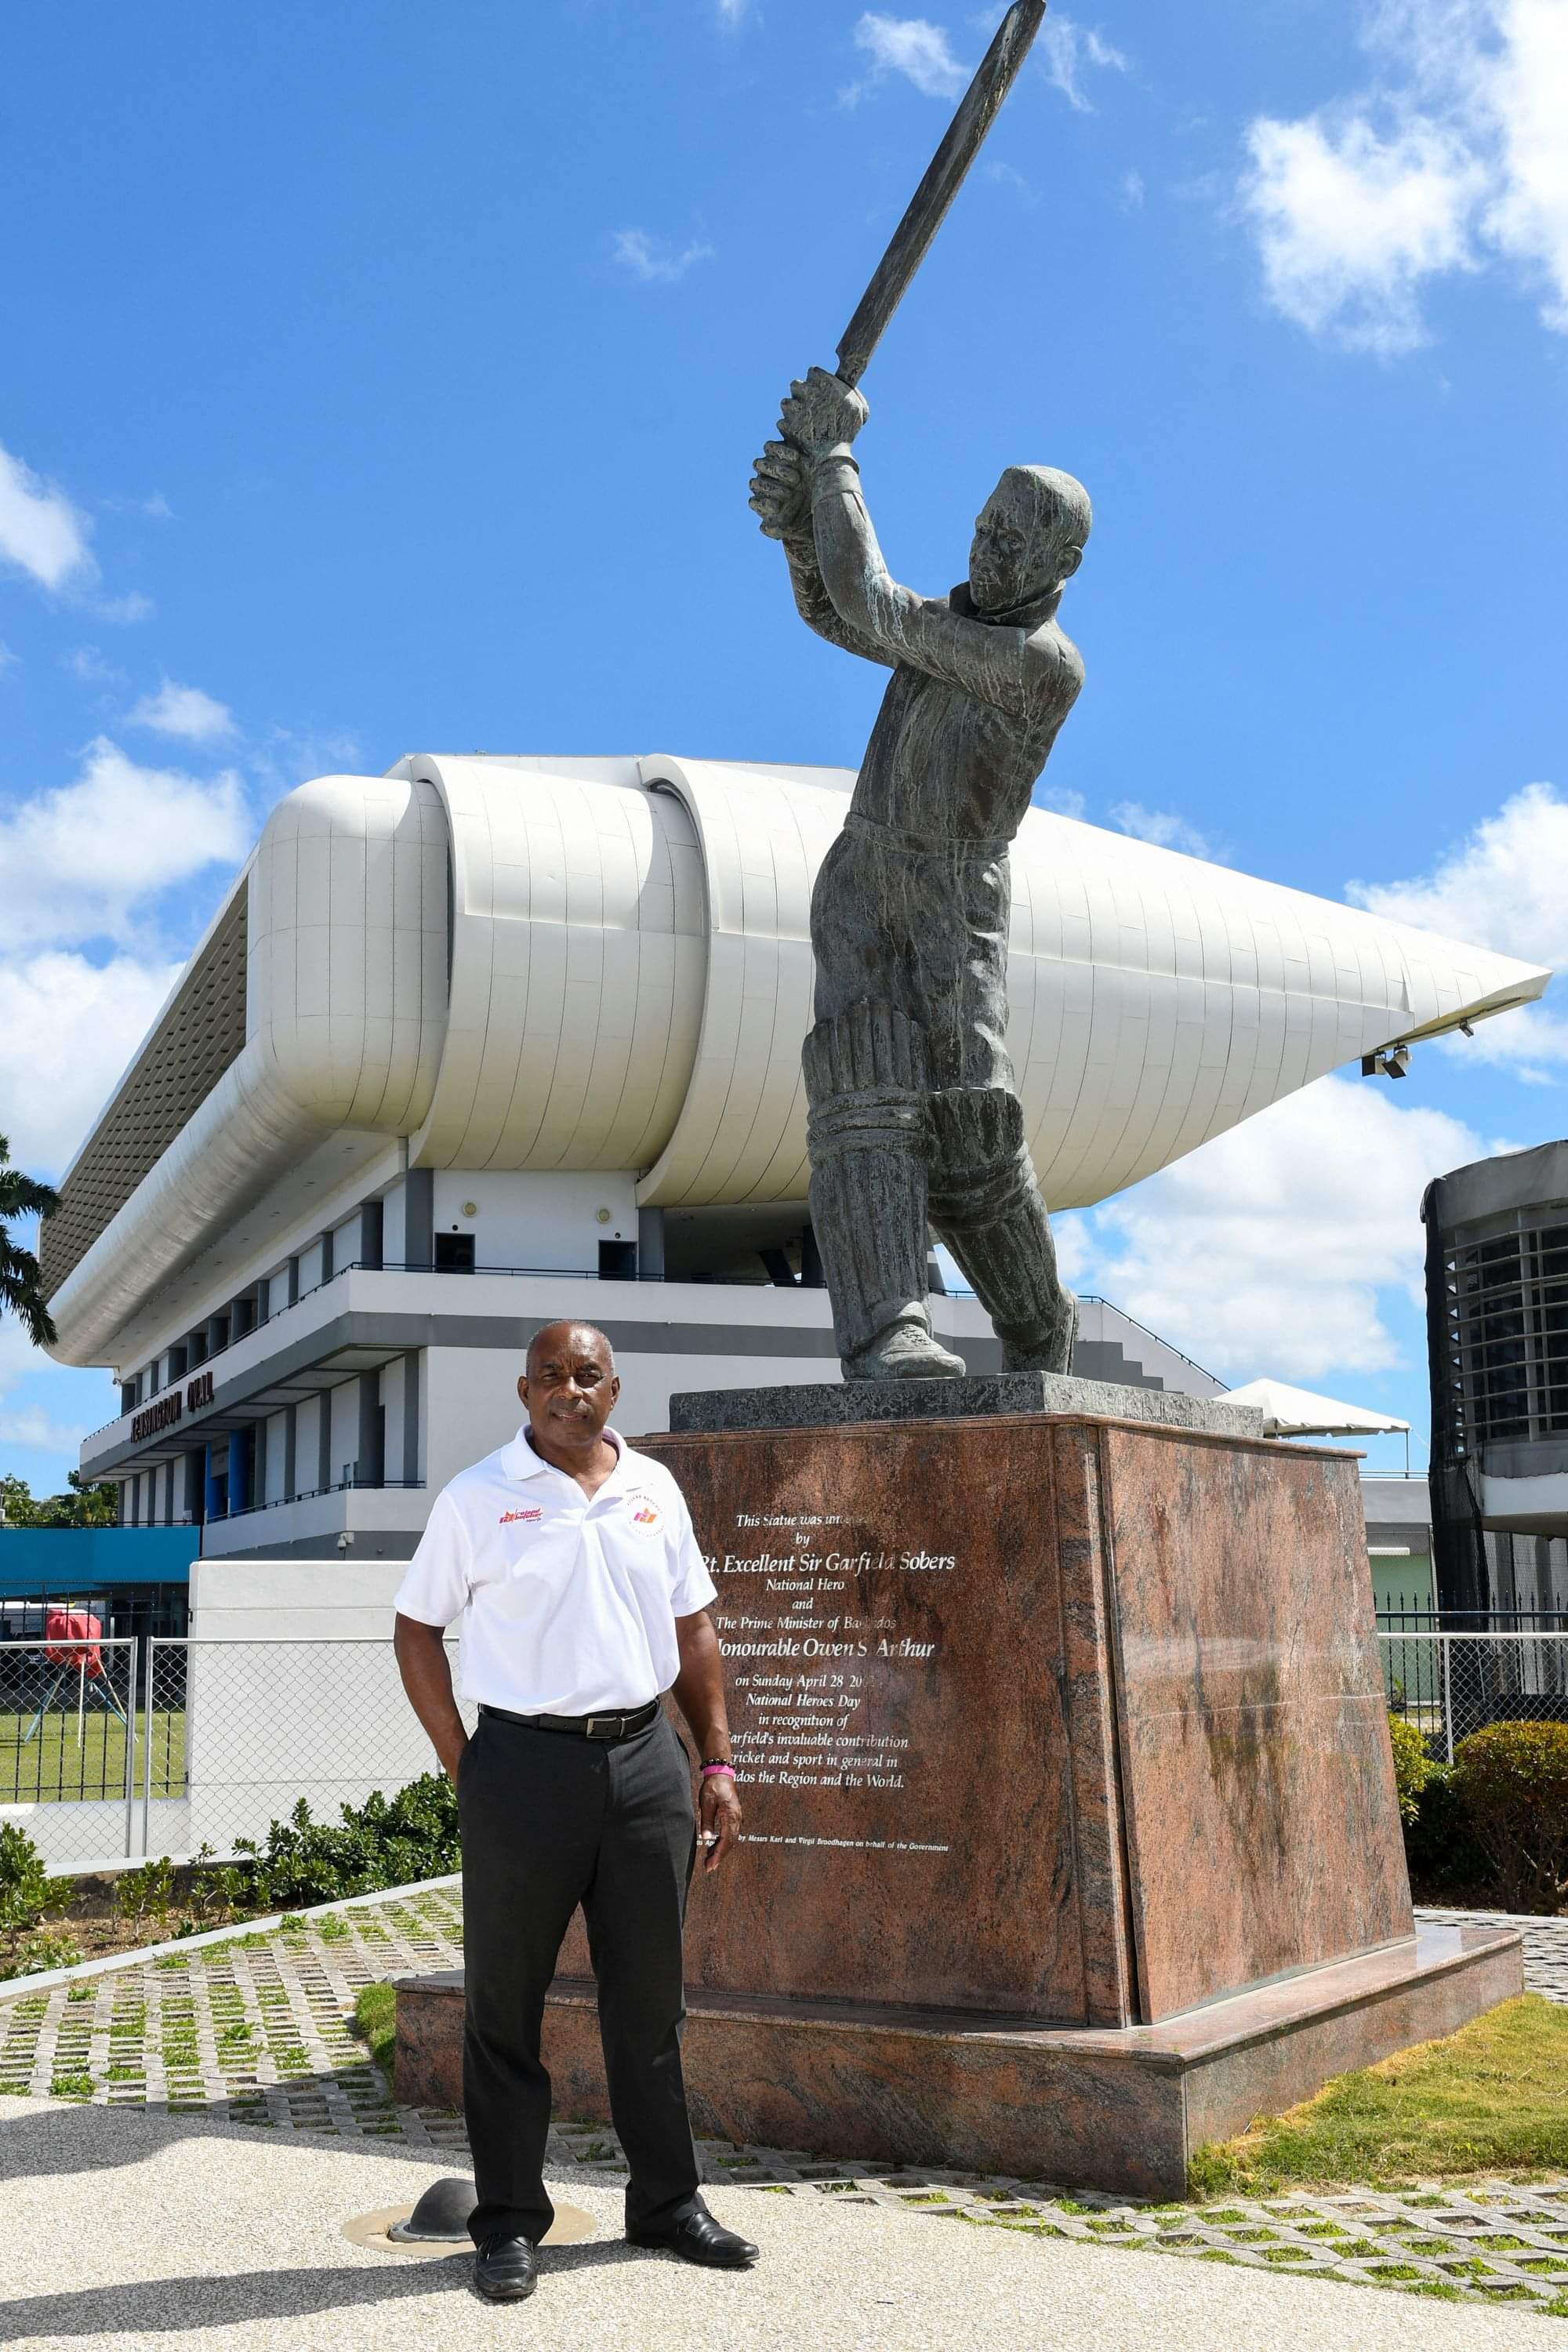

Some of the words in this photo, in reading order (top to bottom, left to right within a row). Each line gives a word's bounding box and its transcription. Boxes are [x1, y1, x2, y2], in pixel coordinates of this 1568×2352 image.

[736, 1515, 760, 1527] This
[763, 1515, 797, 1526] Statue
[800, 1515, 822, 1525] was
[796, 1532, 810, 1548] by
[723, 1554, 795, 1573] Excellent
[799, 1553, 822, 1572] Sir
[826, 1552, 896, 1577] Garfield
[900, 1551, 955, 1570] Sobers
[765, 1577, 814, 1591] National
[817, 1577, 845, 1591] Hero
[792, 1597, 814, 1610] and
[716, 1617, 737, 1629] The
[740, 1617, 773, 1629] Prime
[777, 1617, 824, 1630] Minister
[827, 1616, 840, 1632] of
[804, 1638, 854, 1657] Owen
[877, 1638, 935, 1657] Arthur
[735, 1677, 749, 1686] on
[752, 1675, 793, 1691] Sunday
[797, 1675, 826, 1690] April
[746, 1693, 793, 1706] National
[797, 1693, 834, 1707] Heroes
[838, 1695, 861, 1711] Day
[758, 1712, 769, 1725] in
[772, 1713, 833, 1730] recognition
[837, 1715, 850, 1731] of
[728, 1731, 774, 1748] arfield's
[777, 1733, 833, 1746] invaluable
[837, 1734, 909, 1748] contribution
[731, 1751, 766, 1764] ricket
[768, 1751, 789, 1764] and
[793, 1754, 822, 1769] sport
[826, 1753, 837, 1766] in
[840, 1754, 883, 1770] general
[887, 1755, 898, 1767] in
[758, 1770, 775, 1783] the
[779, 1771, 817, 1788] Region
[820, 1773, 841, 1785] and
[845, 1773, 863, 1786] the
[867, 1774, 904, 1788] World.
[738, 1834, 746, 1842] by
[798, 1837, 815, 1846] Virgil
[887, 1842, 895, 1850] of
[909, 1842, 949, 1852] Government
